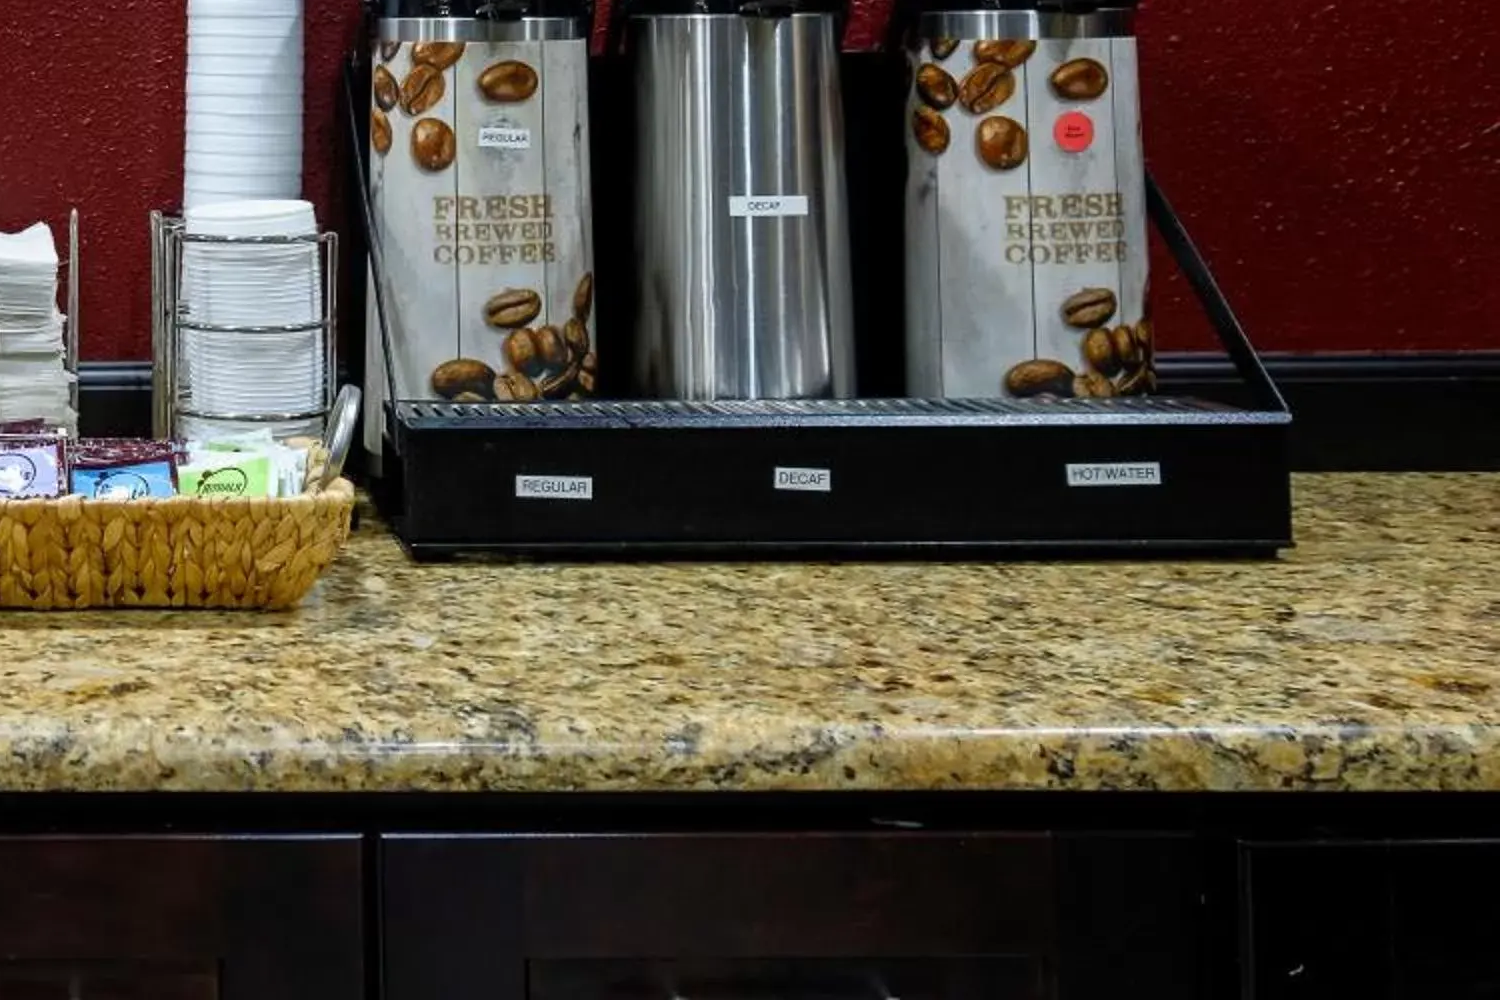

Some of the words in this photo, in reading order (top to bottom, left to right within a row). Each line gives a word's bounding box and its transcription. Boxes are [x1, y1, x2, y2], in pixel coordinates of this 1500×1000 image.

[482, 132, 528, 143] REGULAR
[433, 194, 555, 219] FRESH
[747, 201, 781, 211] DECAF
[1004, 193, 1125, 219] FRESH
[435, 221, 553, 241] BREWED
[1006, 219, 1125, 241] BREWED
[433, 242, 556, 265] COFFEE
[1005, 240, 1127, 264] COFFEE
[779, 471, 829, 485] DECAF
[1073, 467, 1101, 481] HOT
[1105, 467, 1155, 480] WATER
[523, 479, 587, 495] REGULAR
